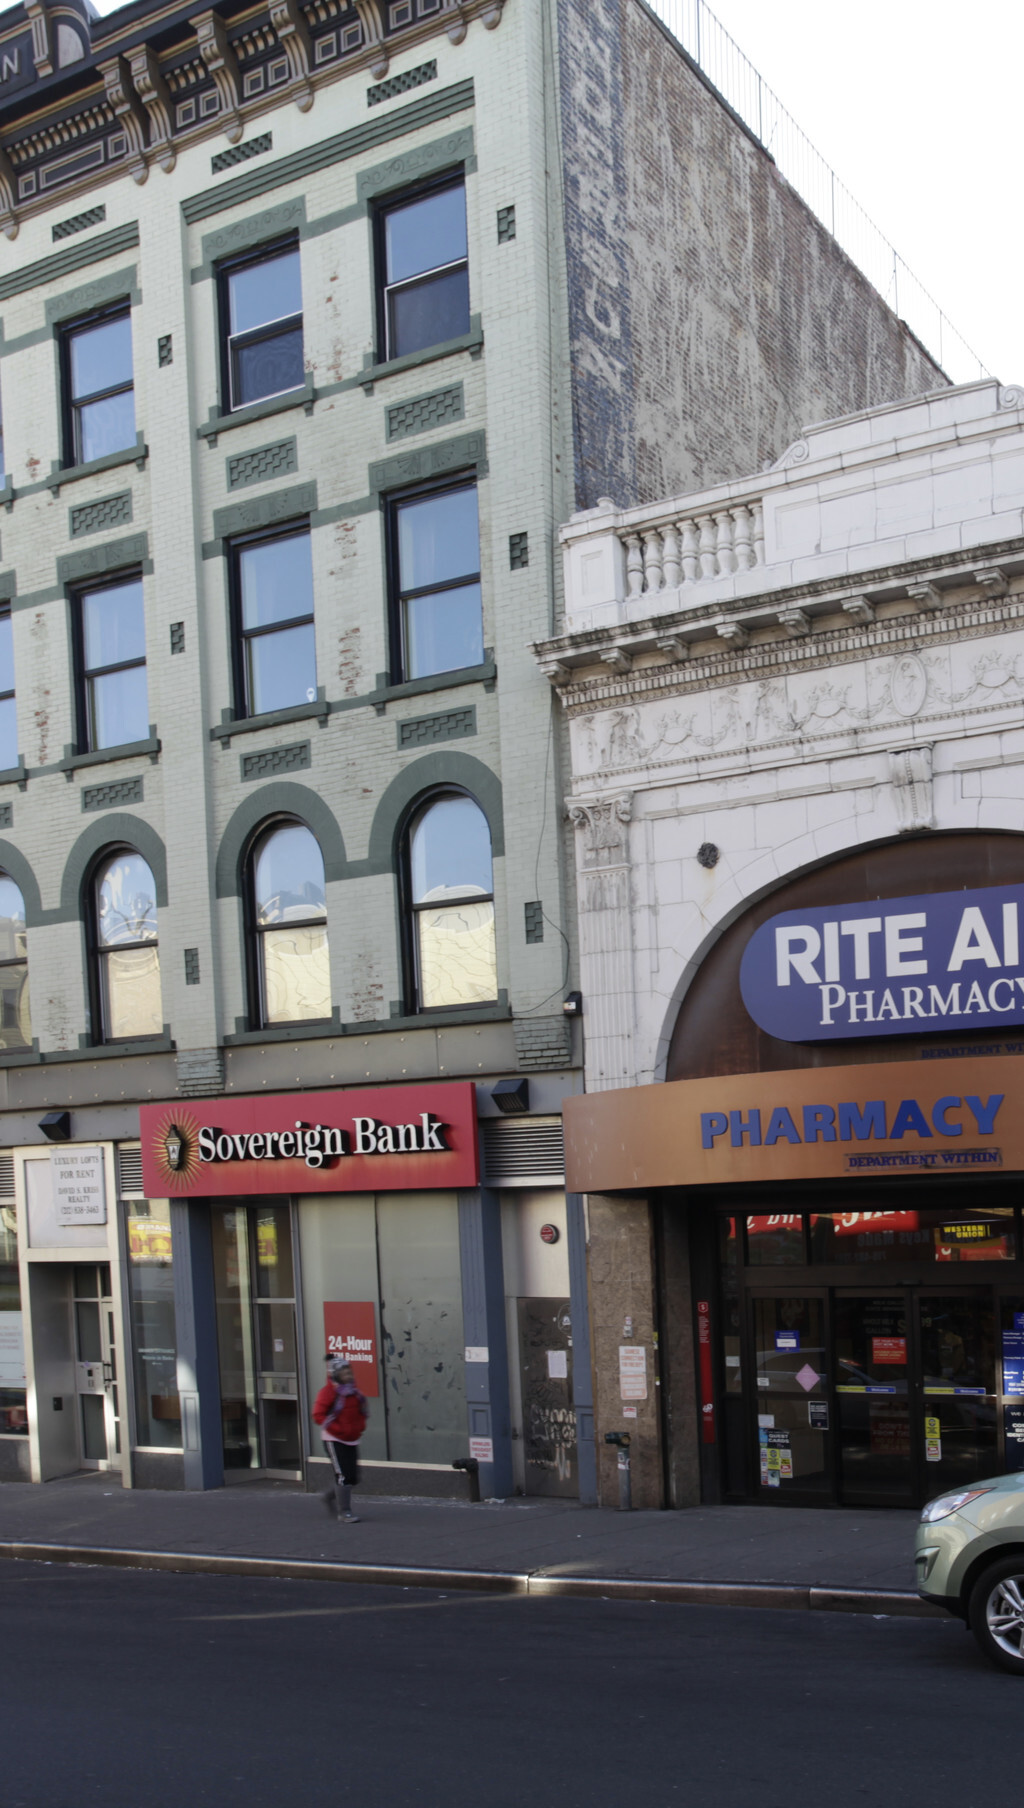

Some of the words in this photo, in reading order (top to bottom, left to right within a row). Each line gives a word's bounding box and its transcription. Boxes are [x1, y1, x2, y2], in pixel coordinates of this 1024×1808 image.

[775, 912, 928, 987] RITE
[921, 1044, 1003, 1059] DEPARTMENT
[700, 1094, 1005, 1149] PHARMACY
[198, 1120, 346, 1169] Sovereign
[352, 1112, 447, 1155] Bank
[848, 1153, 938, 1168] DEPARTMENT
[940, 1152, 999, 1164] WITHIN
[60, 1170, 74, 1179] FOR
[76, 1169, 95, 1178] RENT
[943, 1225, 984, 1234] WESTERN
[328, 1335, 373, 1351] 24-Hour
[345, 1352, 373, 1363] Banking
